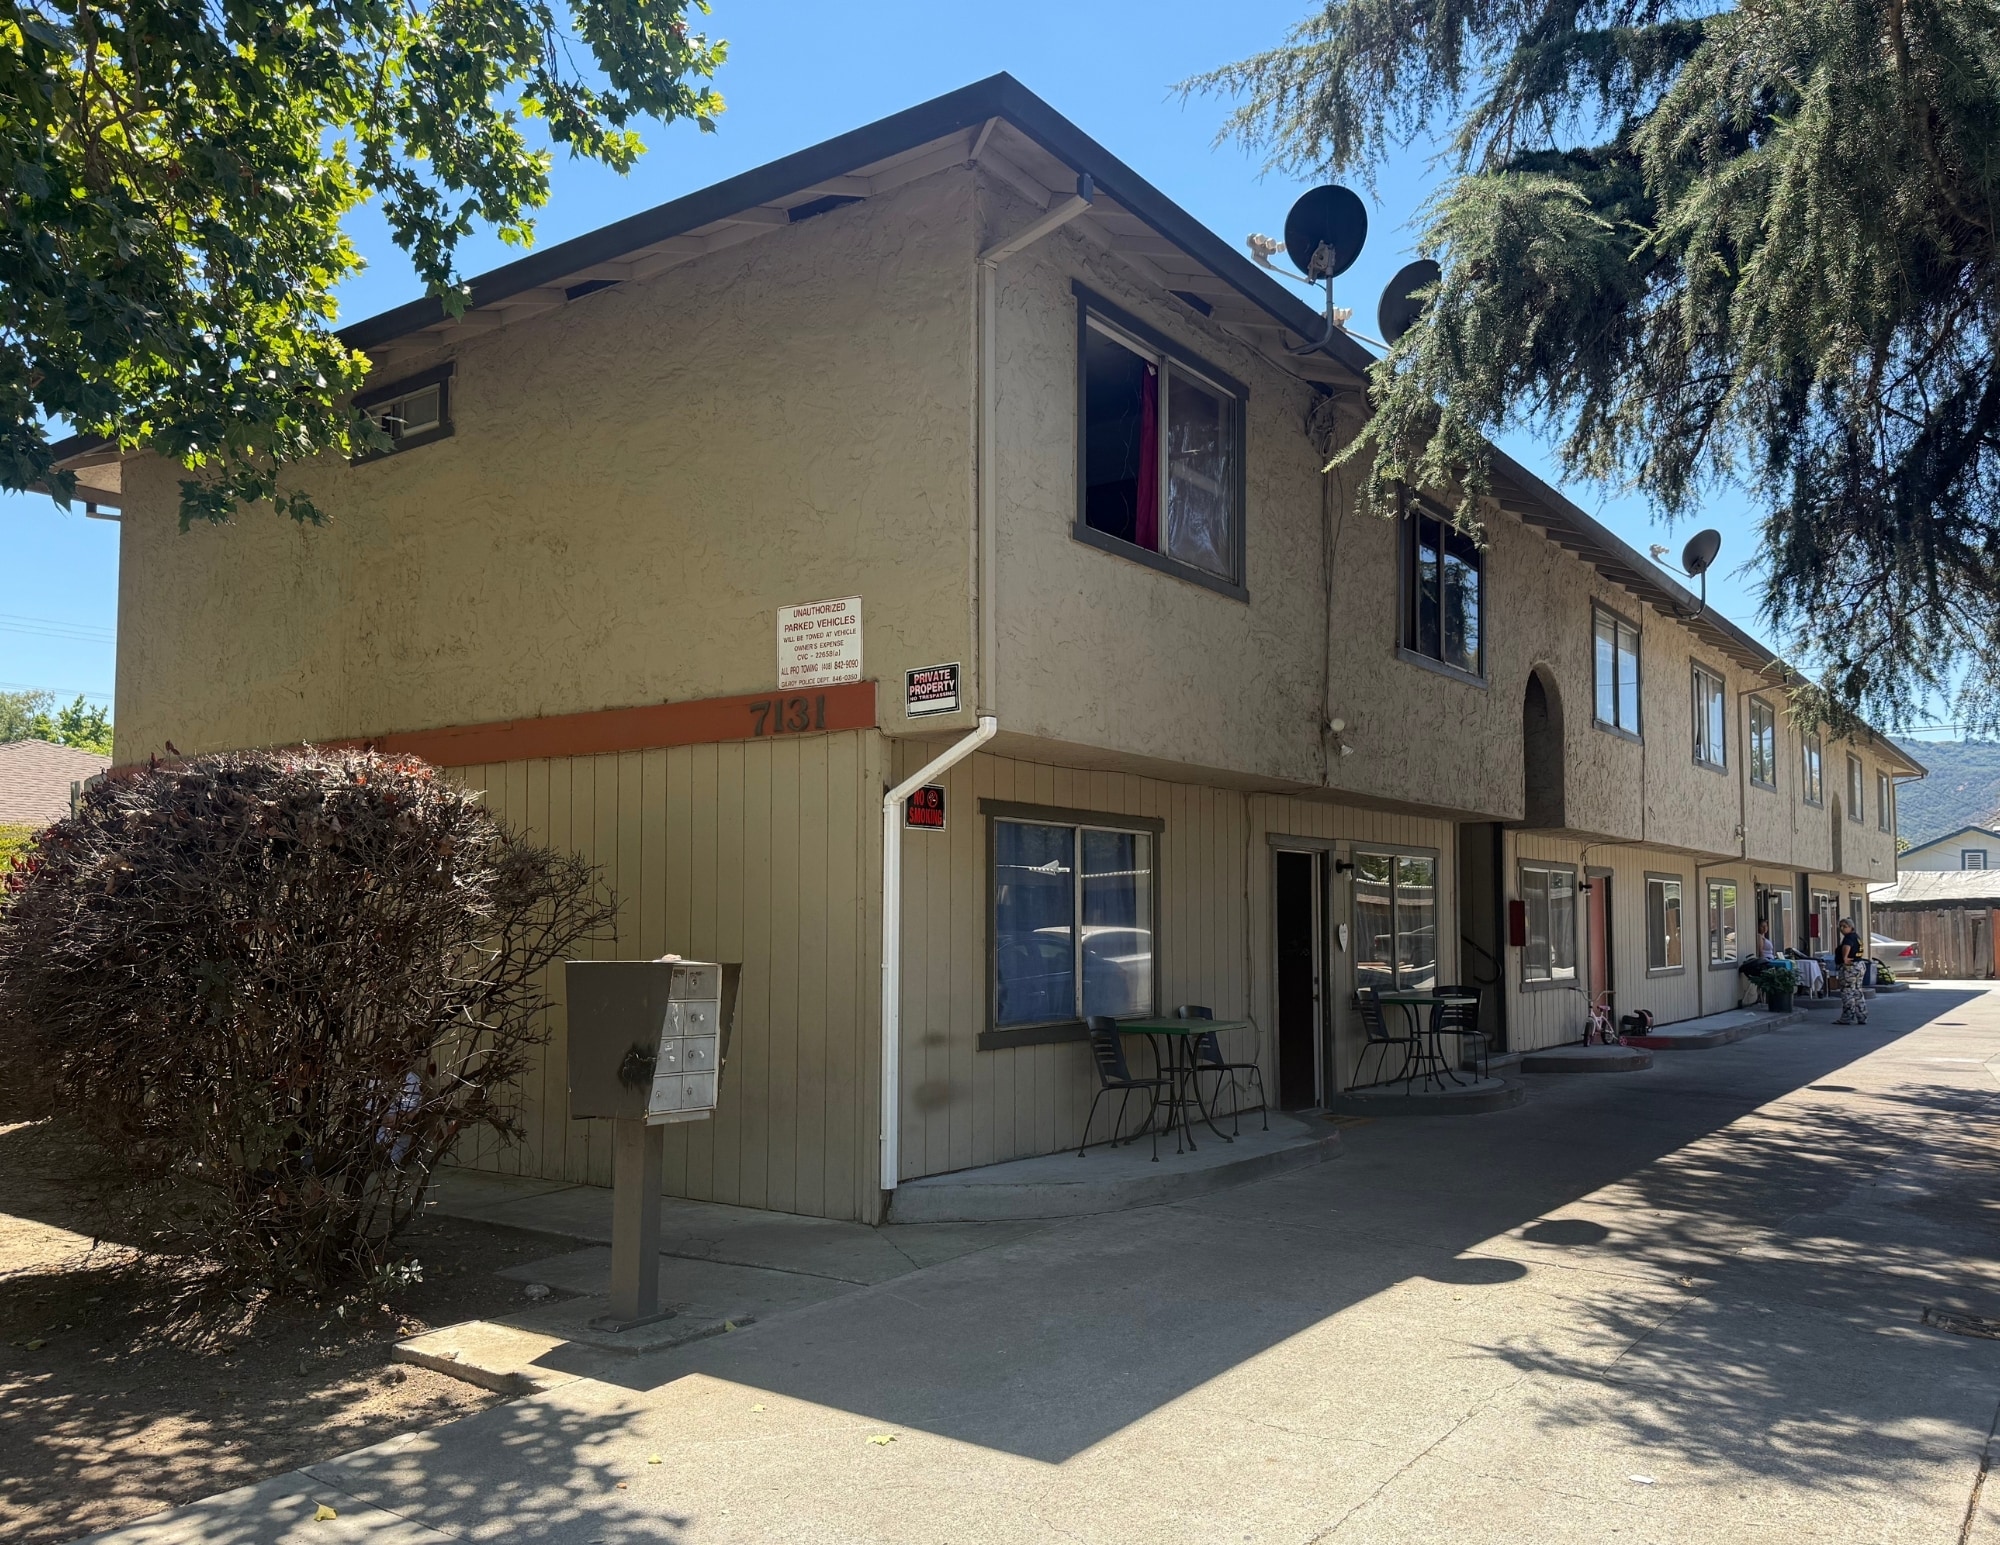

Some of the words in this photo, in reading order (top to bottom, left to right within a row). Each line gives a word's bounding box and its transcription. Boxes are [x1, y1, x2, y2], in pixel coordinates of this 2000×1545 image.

[793, 602, 846, 618] UNAUTHORIZED
[784, 621, 814, 632] PARKED
[817, 614, 856, 628] VEHICLES
[806, 632, 824, 640] TOWED
[834, 628, 856, 636] VEHICLE
[820, 640, 844, 648] EXPENSE
[781, 667, 789, 675] ALL
[790, 666, 799, 675] PRO
[801, 663, 818, 673] TOWING
[914, 669, 951, 683] PRIVATE
[910, 680, 955, 696] PROPERTY
[919, 692, 956, 700] TRESPASSING
[750, 695, 825, 736] 7131
[913, 789, 925, 806] NO
[909, 807, 943, 826] SMOKING
